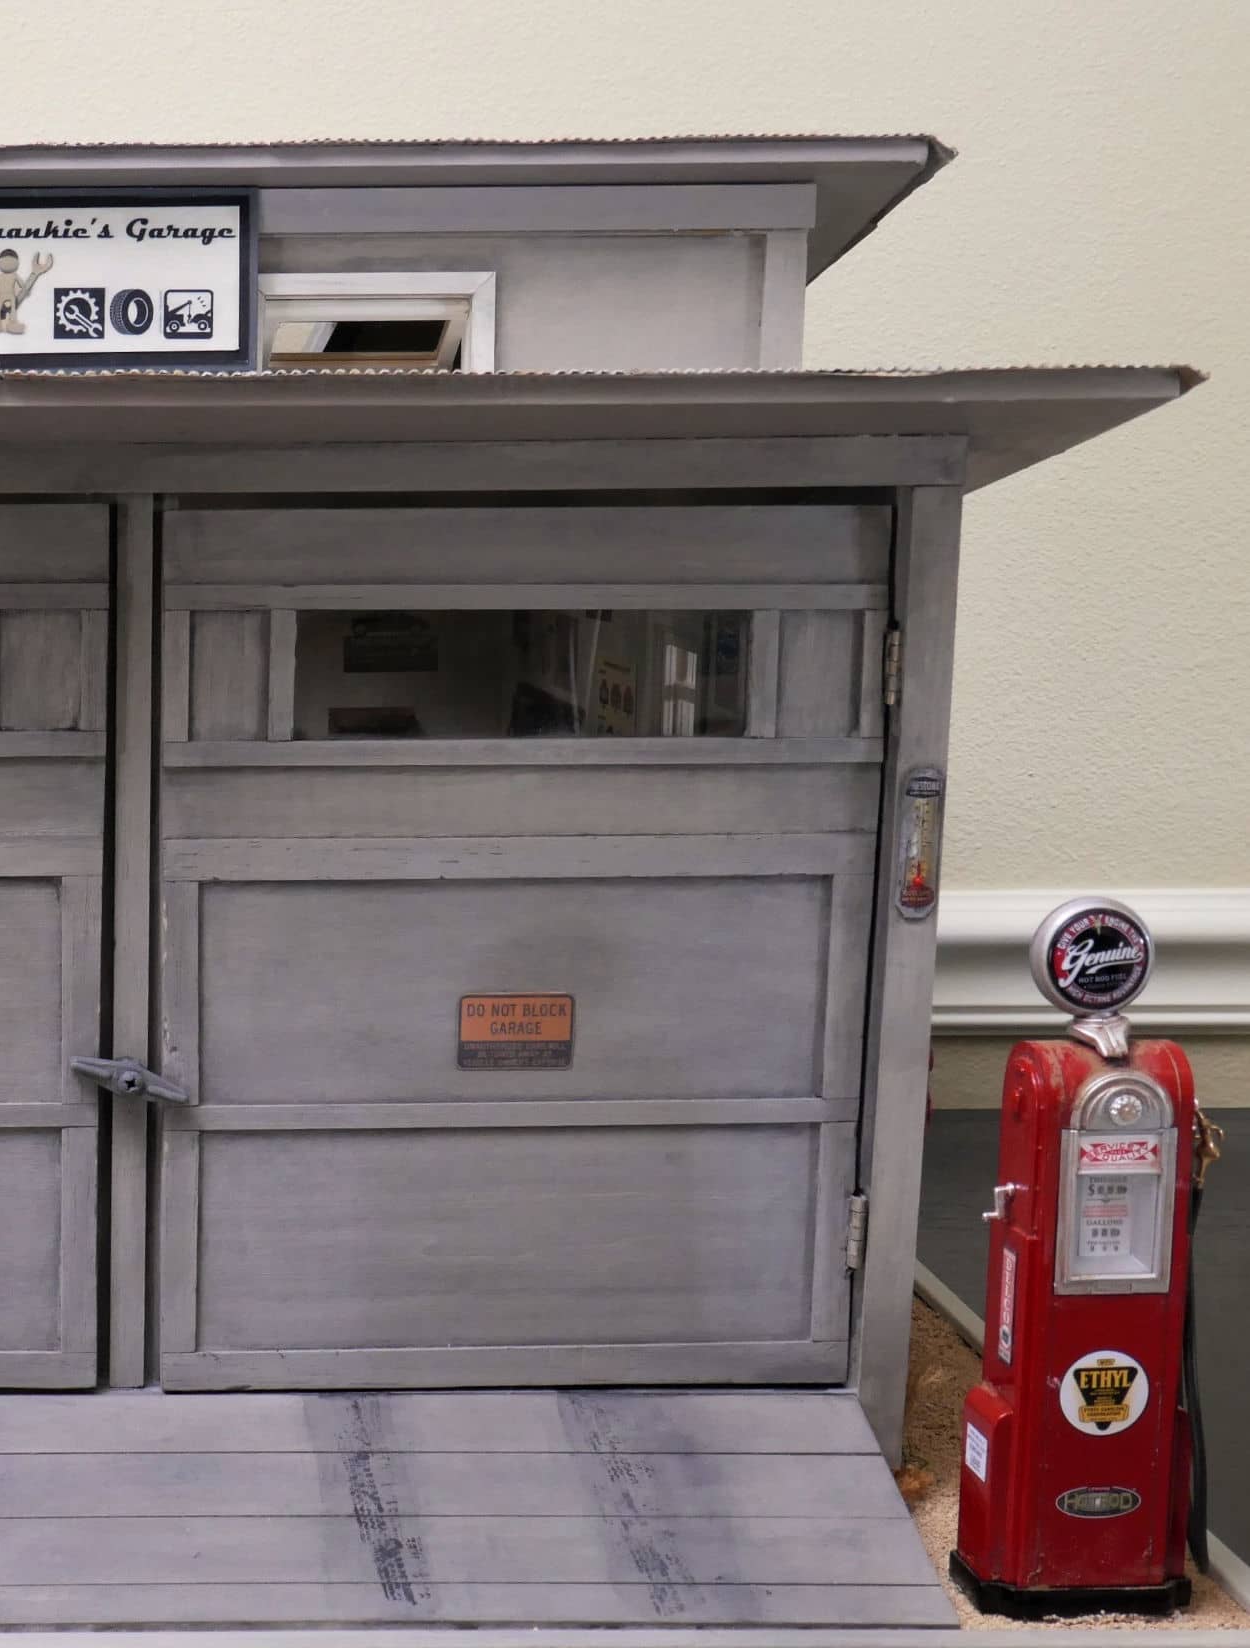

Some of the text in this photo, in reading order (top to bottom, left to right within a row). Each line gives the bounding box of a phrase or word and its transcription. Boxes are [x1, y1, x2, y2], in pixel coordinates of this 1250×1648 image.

[126, 217, 236, 245] Garage
[1058, 939, 1143, 988] Genuine
[467, 1003, 567, 1017] DO NOT BLOCK
[490, 1021, 542, 1035] GARAGE
[1080, 1370, 1131, 1389] ETHYL
